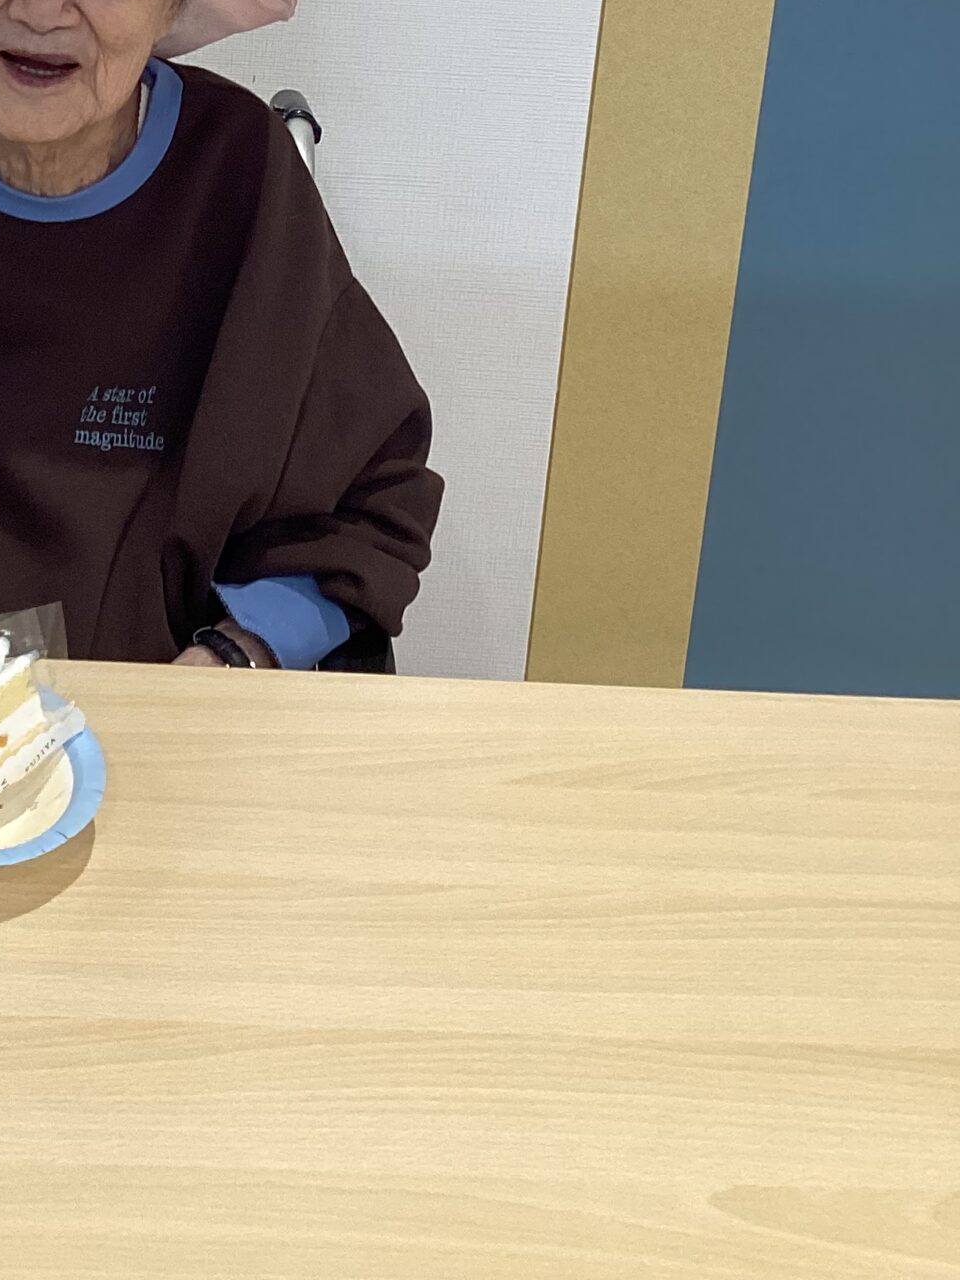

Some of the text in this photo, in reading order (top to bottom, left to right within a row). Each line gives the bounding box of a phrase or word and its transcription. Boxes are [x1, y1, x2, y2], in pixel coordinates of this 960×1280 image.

[86, 385, 157, 404] A star of
[80, 404, 148, 427] the first
[73, 428, 165, 451] magnitude
